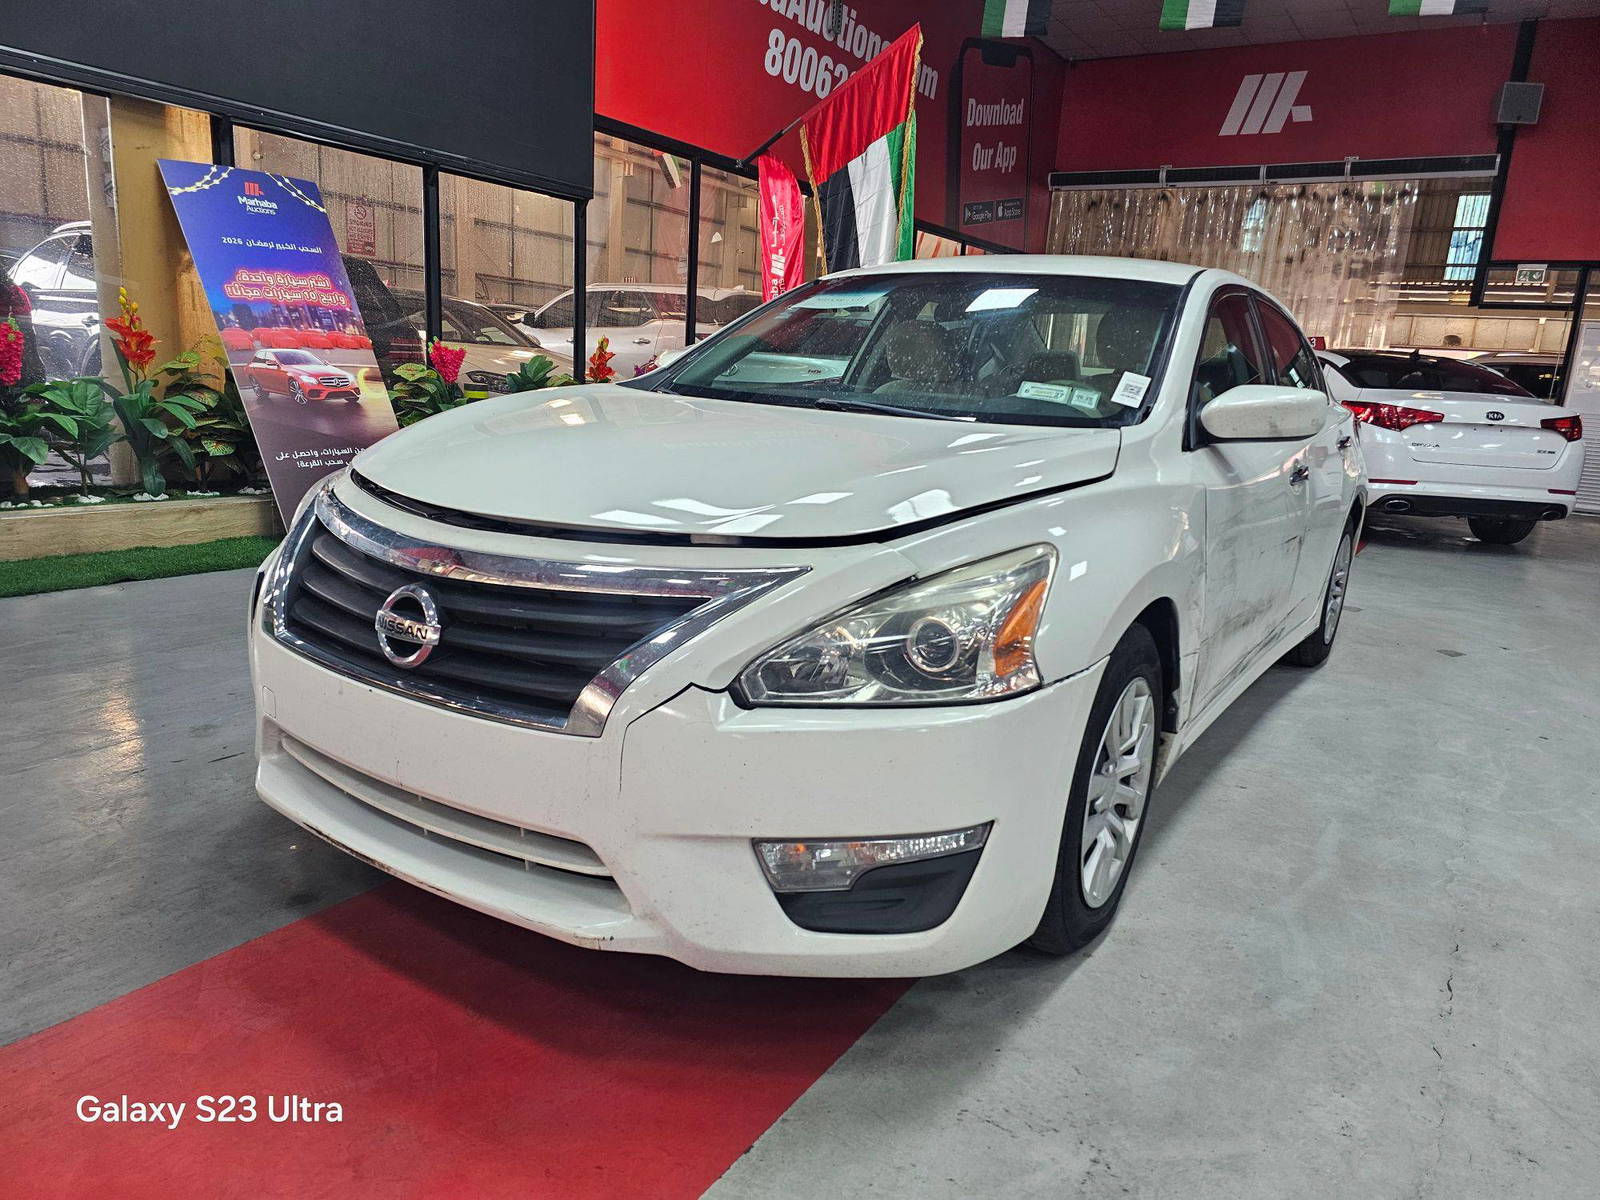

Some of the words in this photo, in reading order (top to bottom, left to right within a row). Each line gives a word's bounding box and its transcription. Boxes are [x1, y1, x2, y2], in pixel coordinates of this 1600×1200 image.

[764, 28, 857, 100] 80062
[966, 98, 1024, 127] Download
[972, 142, 994, 171] Our
[994, 141, 1017, 174] App
[237, 195, 278, 209] Marhaba
[246, 204, 276, 216] Auctions
[221, 236, 243, 245] 2026
[246, 239, 275, 249] لرمضان
[276, 243, 297, 251] الكبير
[298, 245, 322, 254] السحب
[277, 275, 308, 287] سيارة
[264, 288, 302, 301] سيارات
[303, 290, 317, 301] 10
[1488, 411, 1503, 420] KIA
[275, 451, 290, 461] على
[292, 449, 319, 459] واحصل
[324, 459, 343, 467] سحب
[376, 612, 428, 640] NISSAN
